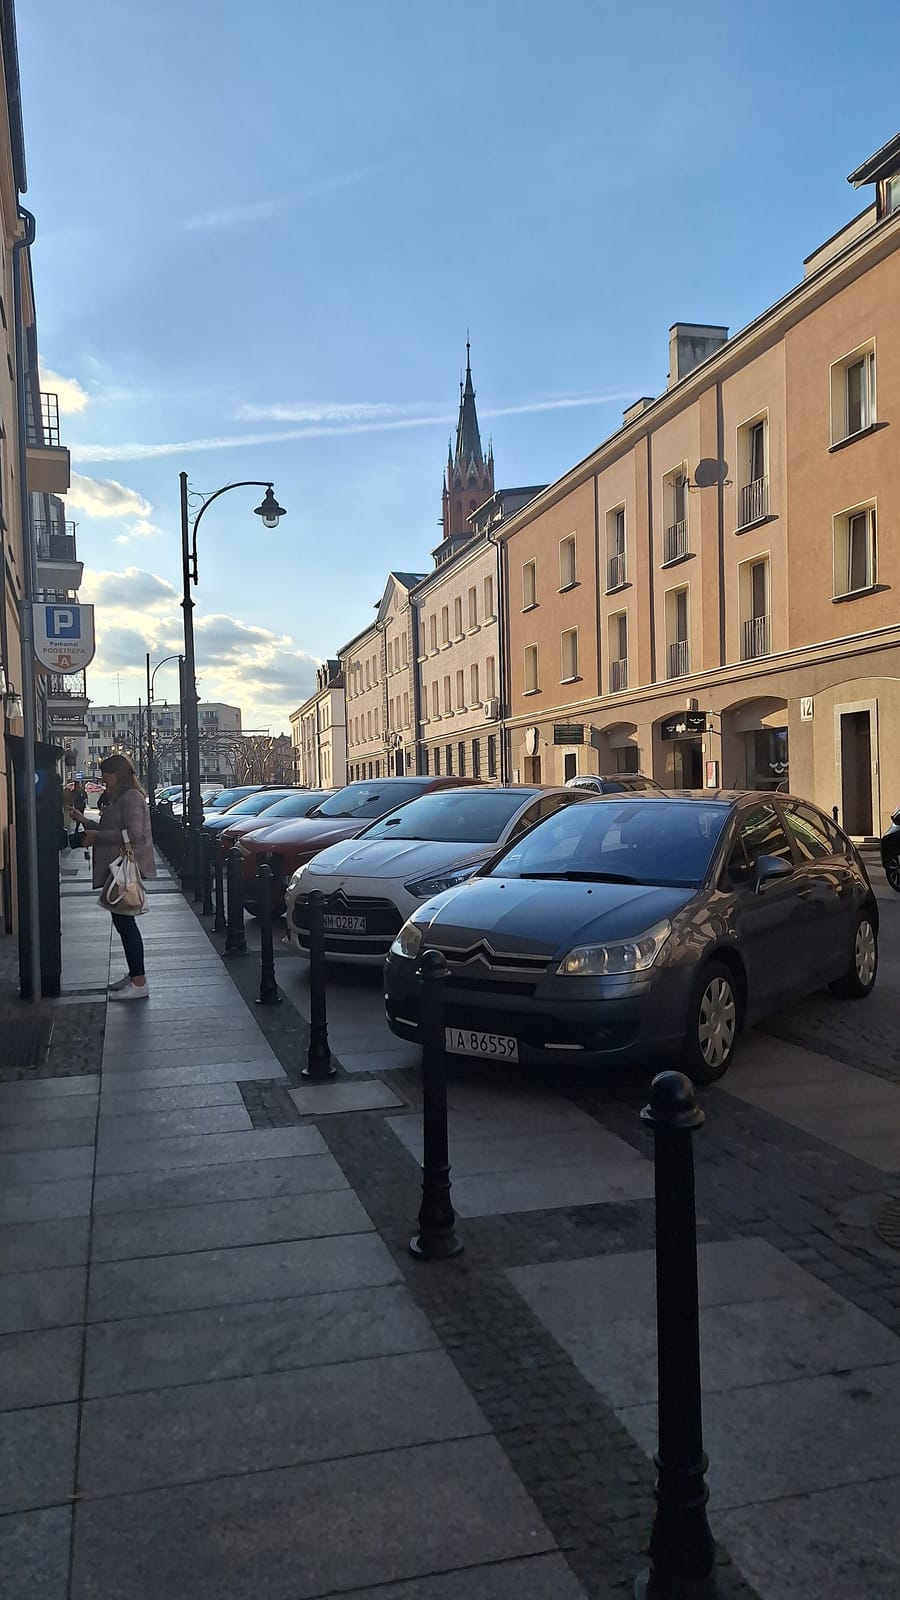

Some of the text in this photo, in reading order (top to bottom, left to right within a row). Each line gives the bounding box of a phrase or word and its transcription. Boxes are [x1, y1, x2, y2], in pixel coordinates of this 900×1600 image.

[53, 609, 74, 635] P
[60, 656, 70, 667] A
[801, 698, 812, 716] 12
[336, 915, 366, 930] 02874
[470, 1033, 516, 1056] 86559
